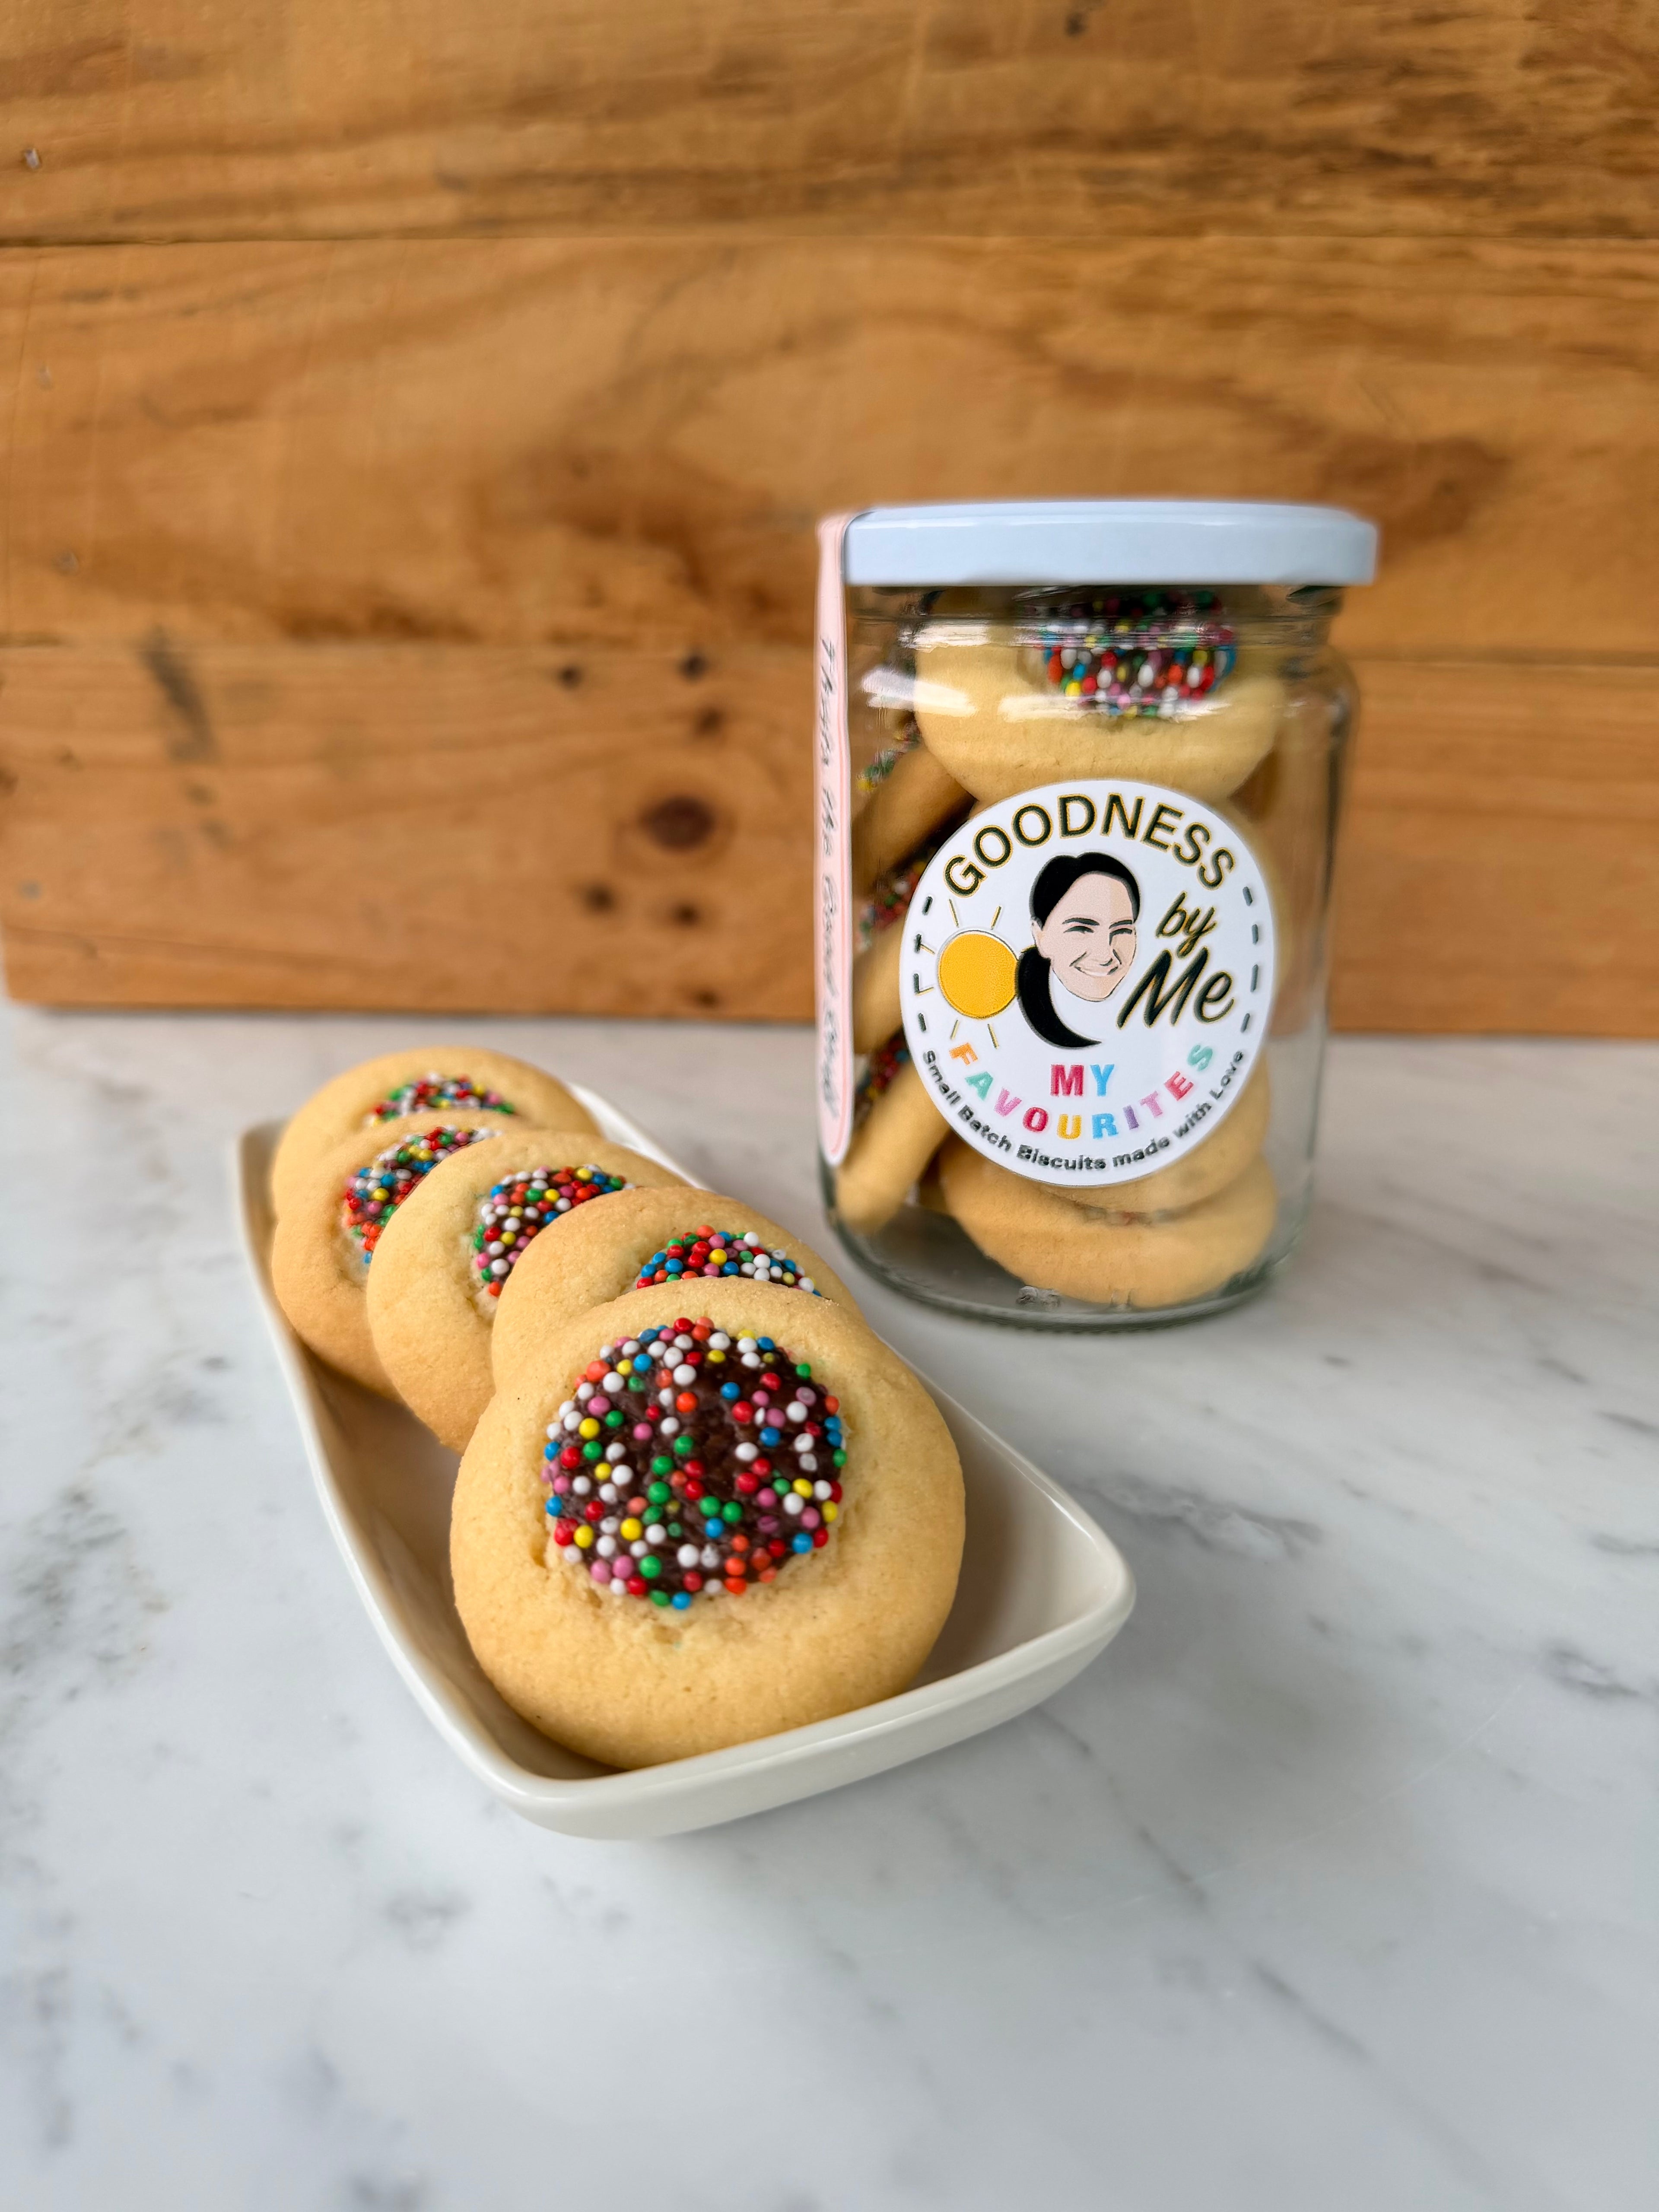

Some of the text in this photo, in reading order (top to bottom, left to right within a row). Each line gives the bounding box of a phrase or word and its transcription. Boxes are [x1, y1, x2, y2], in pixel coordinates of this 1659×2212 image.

[943, 793, 1235, 897] GOODNESS
[1157, 891, 1217, 959] by
[1116, 947, 1234, 1030] Me
[923, 1051, 1244, 1170] Small Batch Biscuits made with Love
[949, 1042, 1214, 1140] FAVOURITES
[1050, 1065, 1115, 1096] MY
